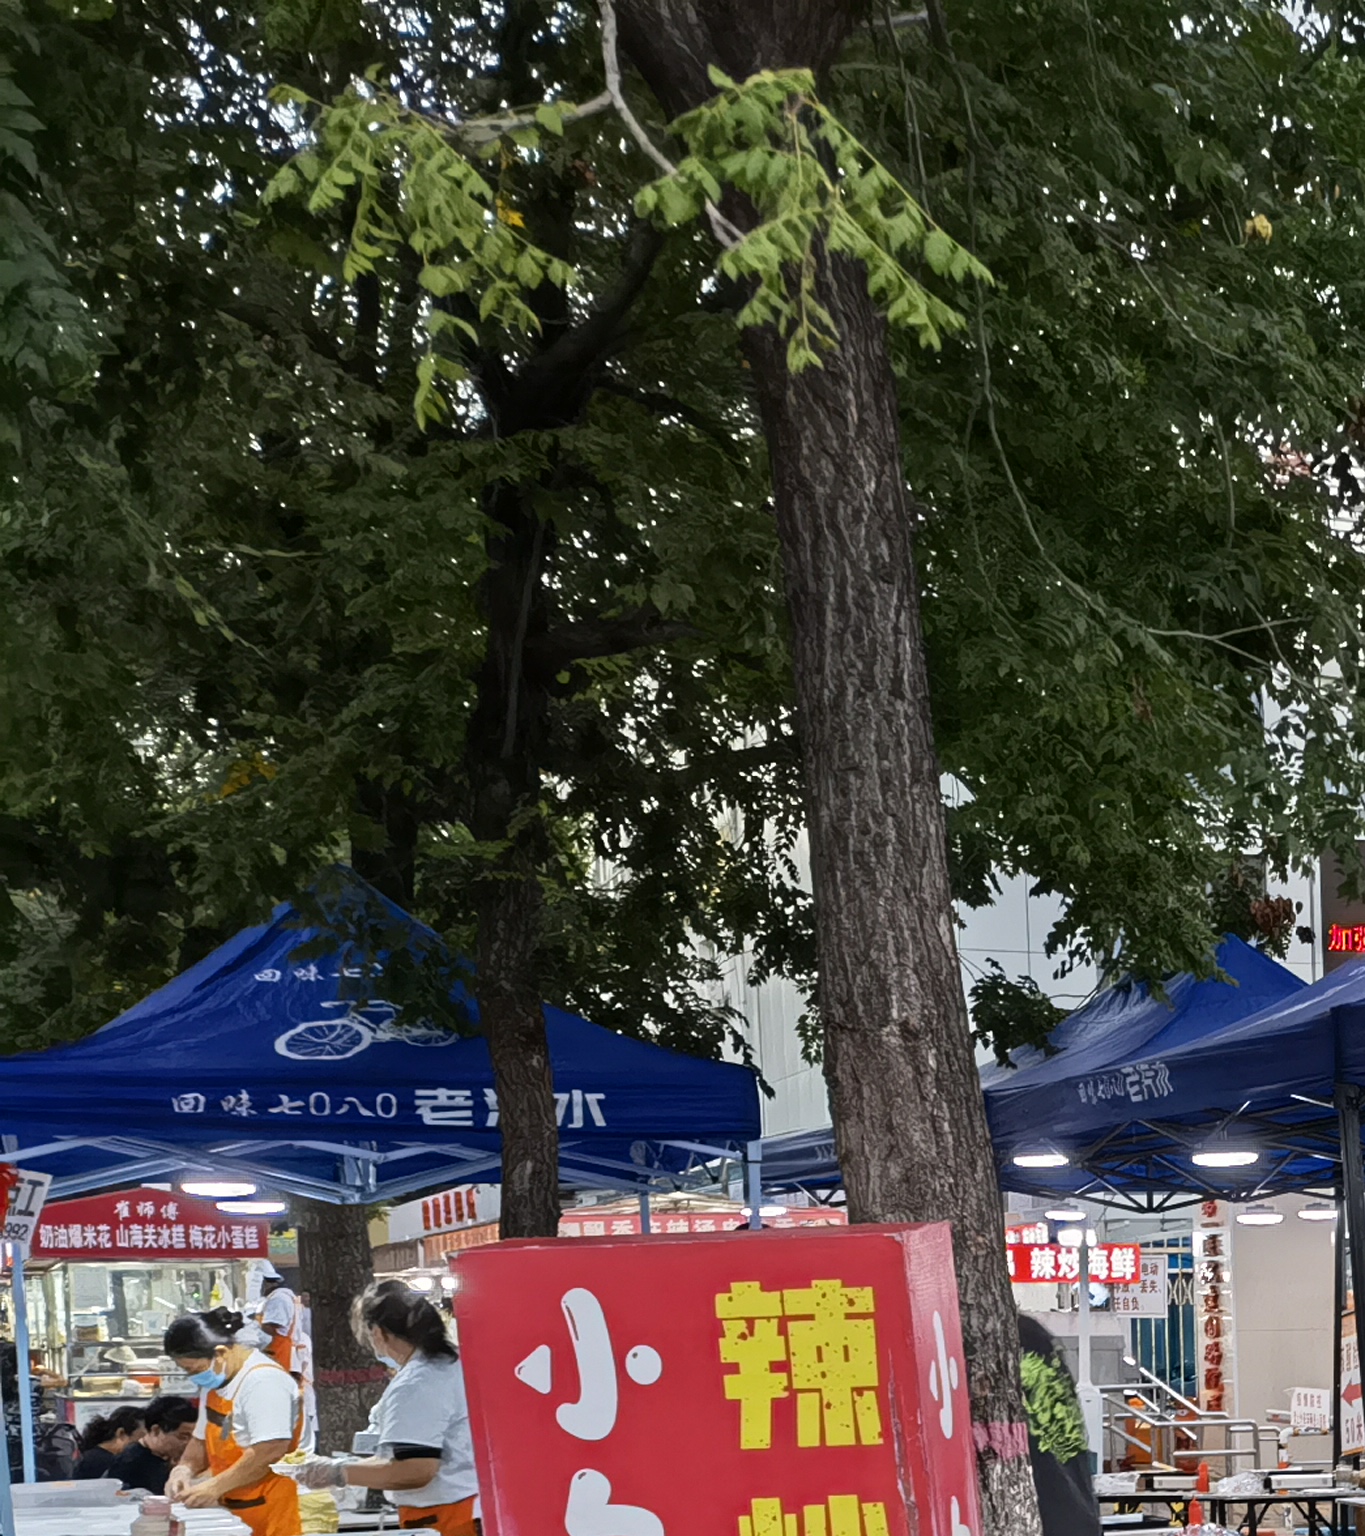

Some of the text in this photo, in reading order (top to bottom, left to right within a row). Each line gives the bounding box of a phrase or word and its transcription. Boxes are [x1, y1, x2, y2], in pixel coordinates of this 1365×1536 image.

[115, 1224, 187, 1249] 山海关冰糕
[1030, 1247, 1136, 1280] 辣炒海鲜
